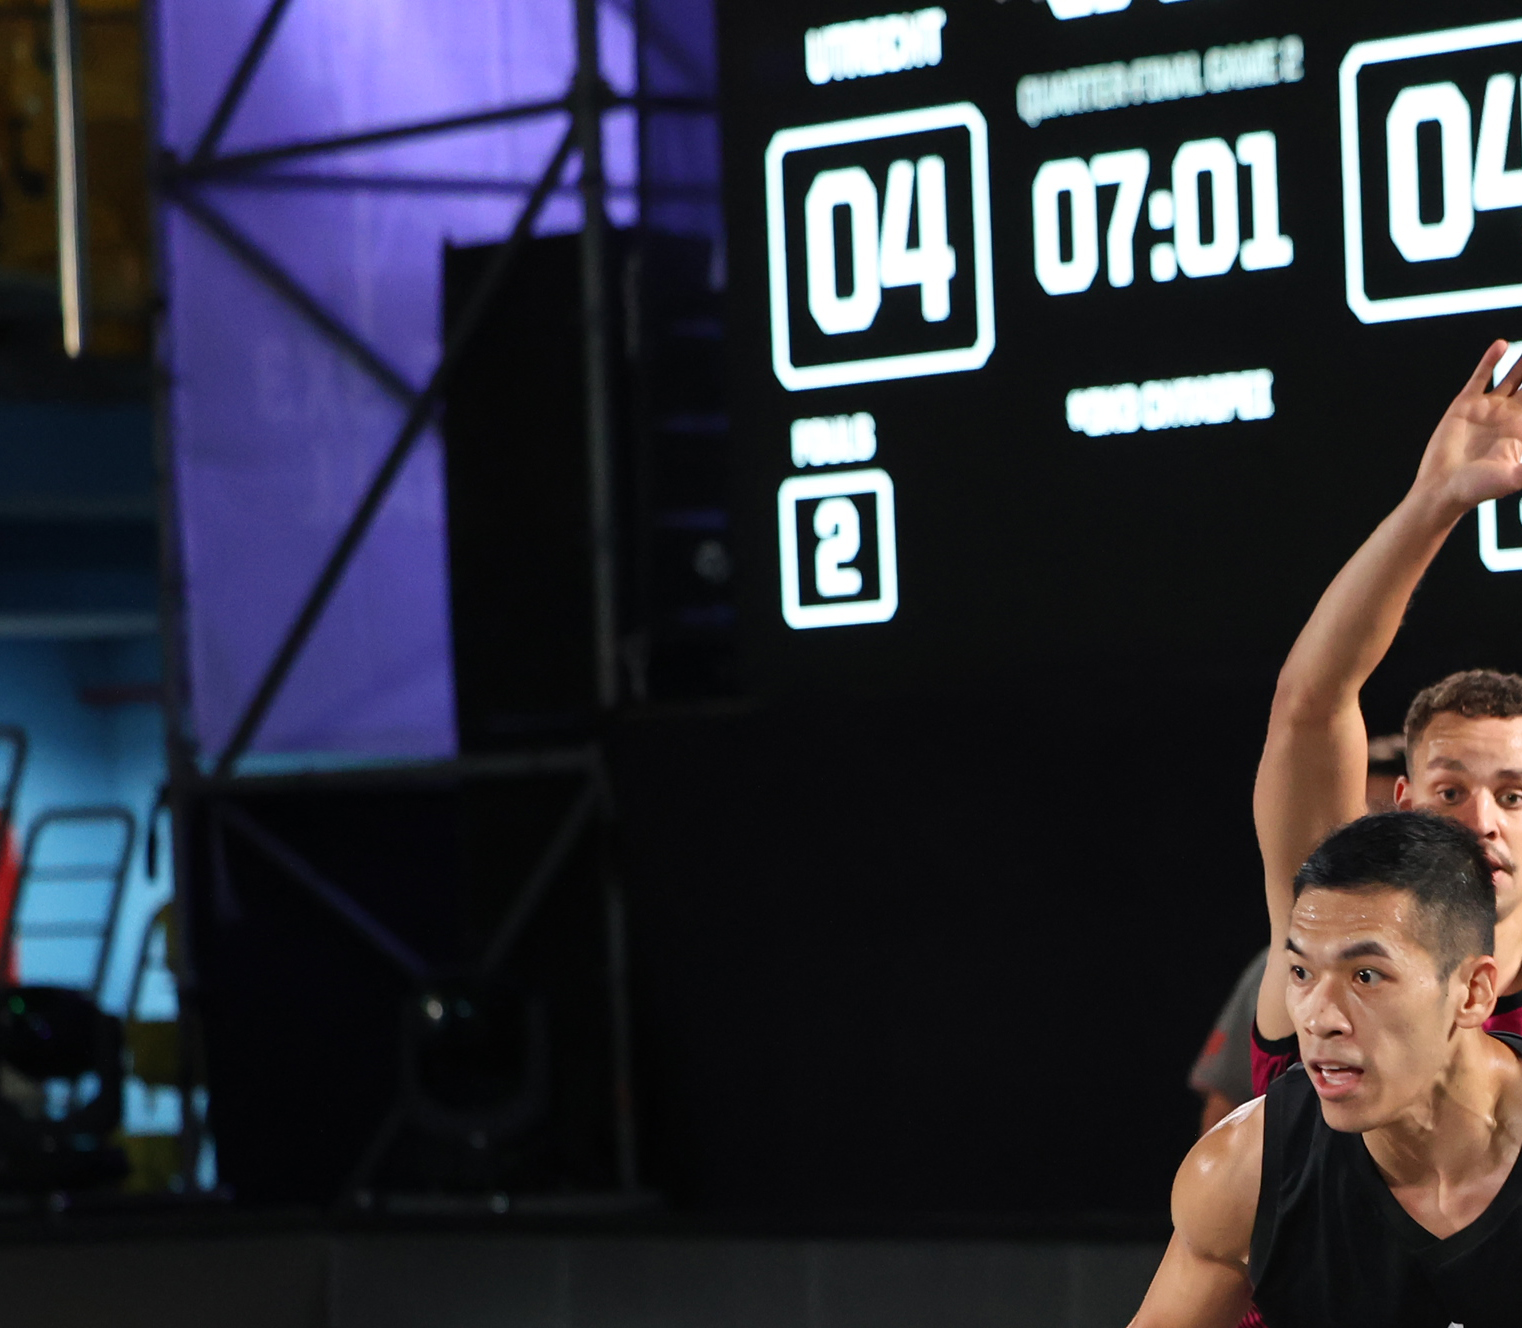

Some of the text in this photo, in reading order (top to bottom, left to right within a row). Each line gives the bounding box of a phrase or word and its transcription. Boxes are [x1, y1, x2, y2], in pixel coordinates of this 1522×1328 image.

[804, 154, 957, 336] 04
[1031, 130, 1294, 296] 07:01
[813, 496, 863, 598] 2
